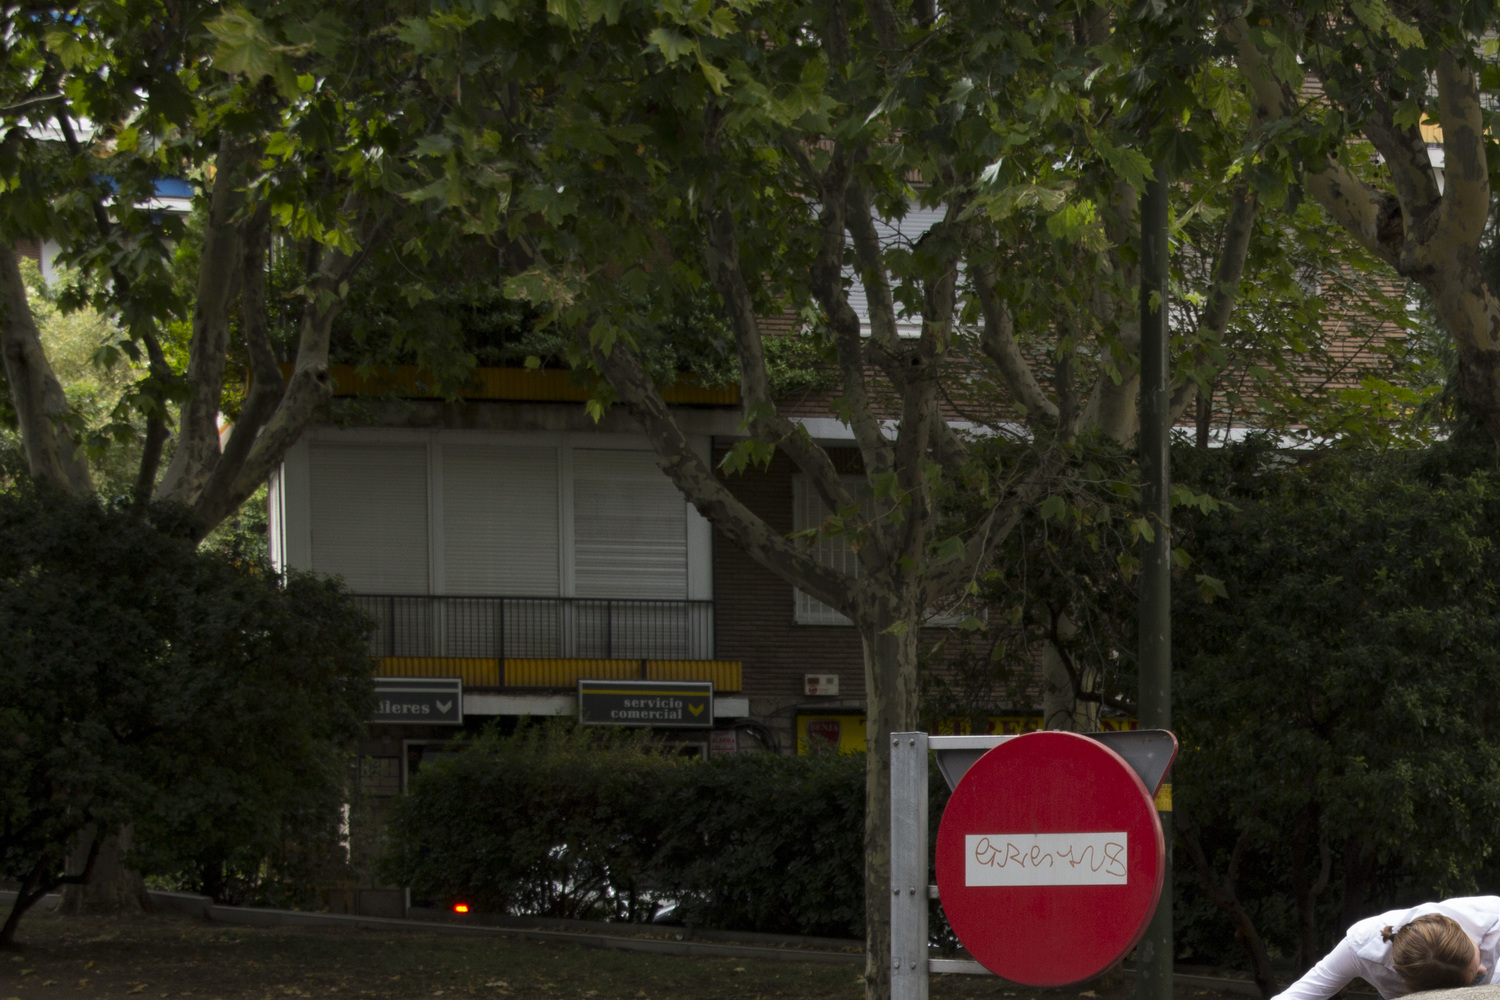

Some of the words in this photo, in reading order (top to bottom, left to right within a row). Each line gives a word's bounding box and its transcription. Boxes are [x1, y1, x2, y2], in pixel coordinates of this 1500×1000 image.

[375, 700, 430, 715] lleres
[623, 697, 683, 708] servicio
[610, 707, 683, 719] comercial
[810, 722, 838, 732] BENJA
